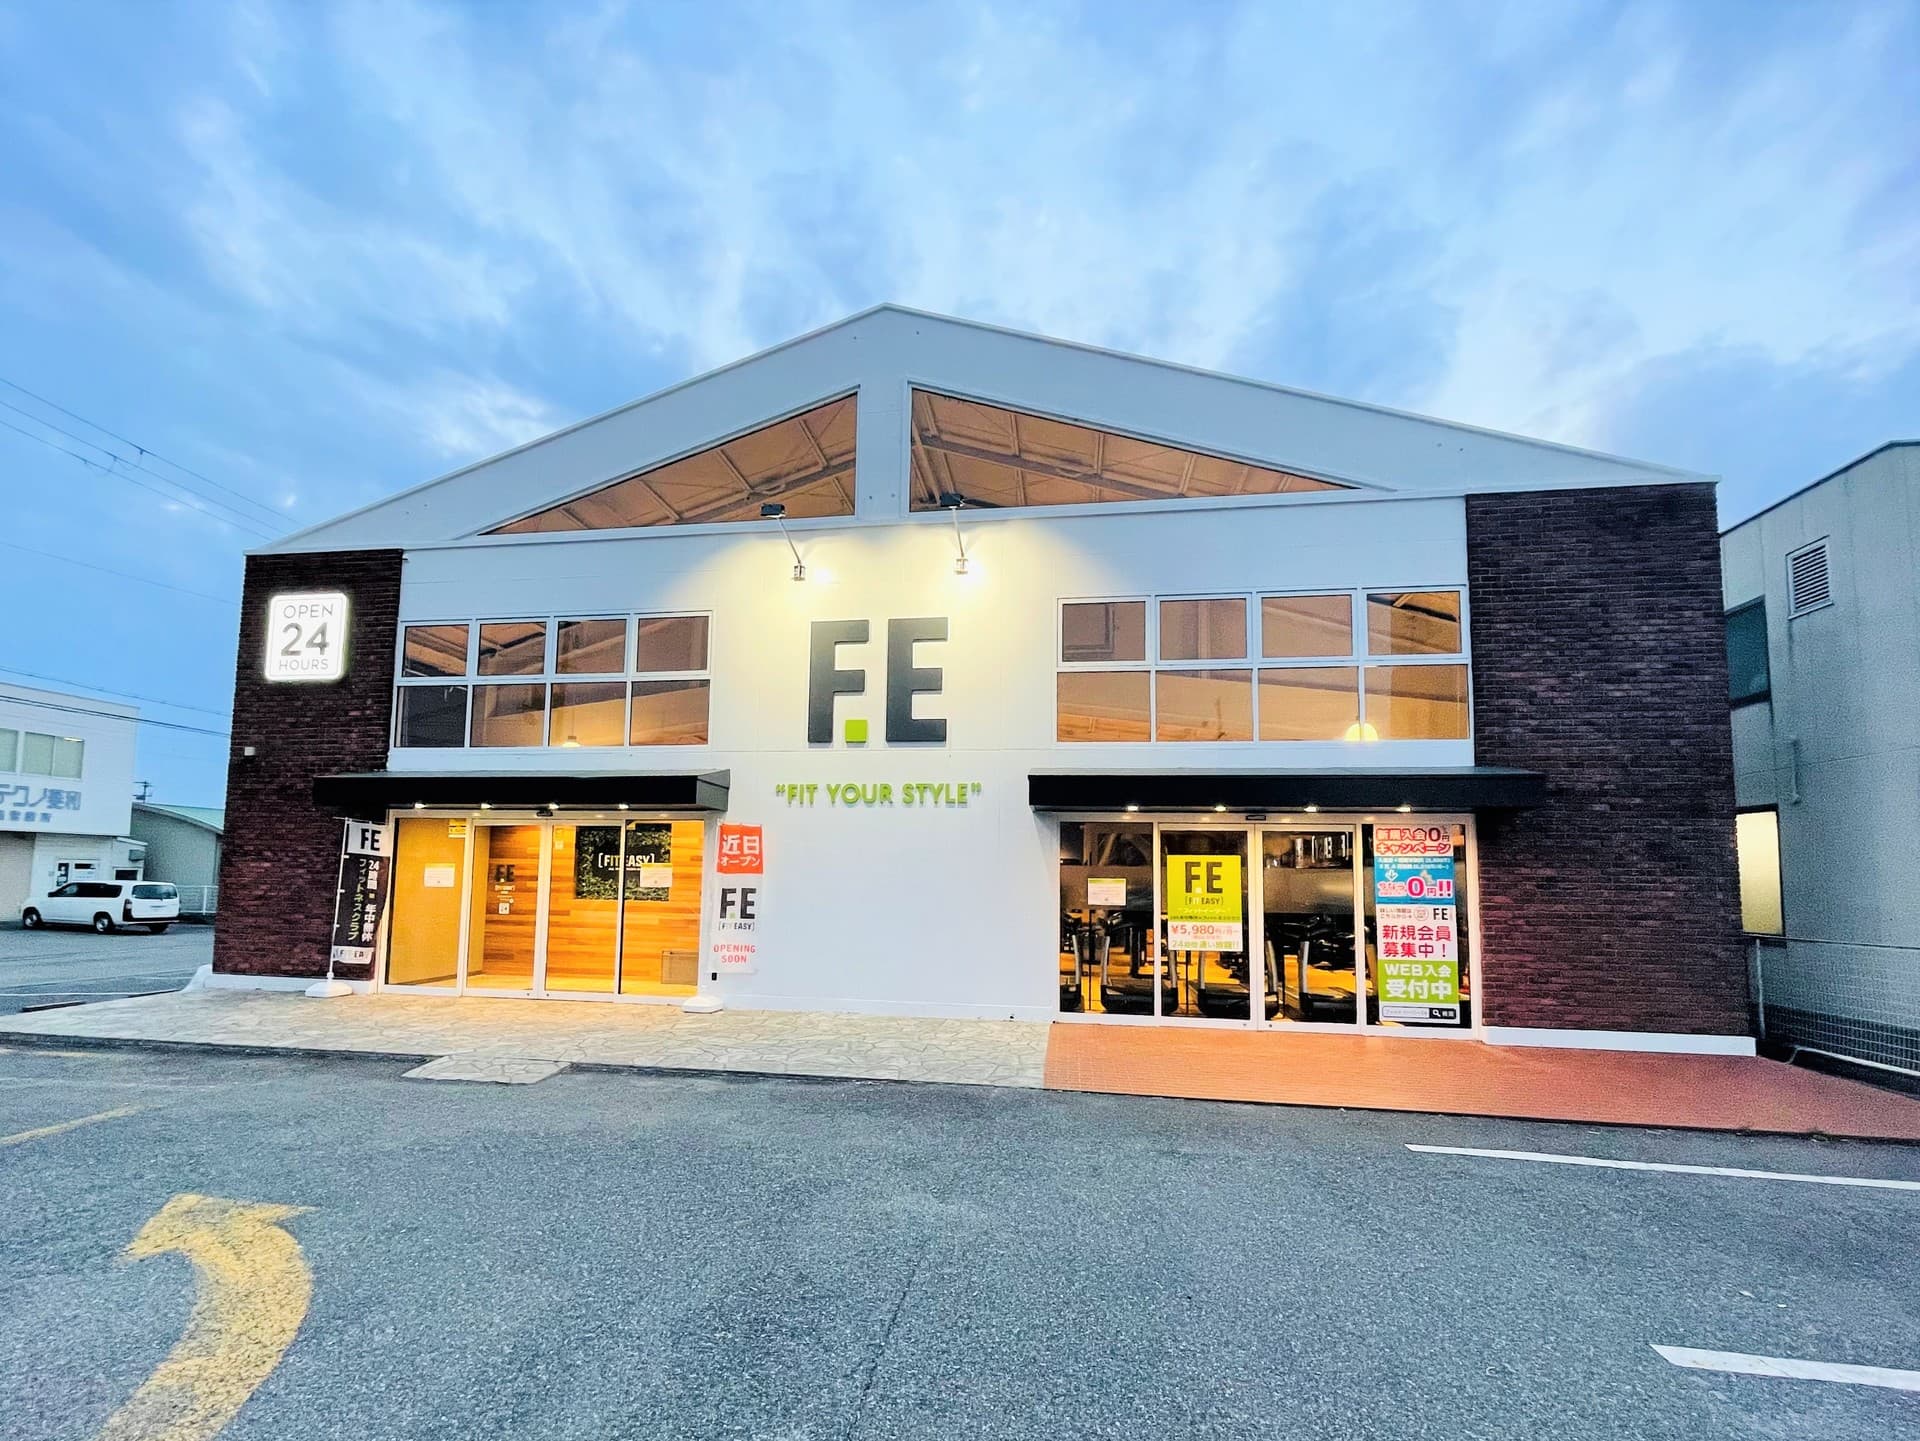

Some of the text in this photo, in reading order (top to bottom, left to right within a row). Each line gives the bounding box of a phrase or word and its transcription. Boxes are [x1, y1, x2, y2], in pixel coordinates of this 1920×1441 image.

[283, 603, 334, 619] OPEN
[280, 622, 330, 657] 24
[279, 658, 329, 672] HOURS
[826, 783, 894, 805] YOUR
[722, 834, 760, 855] 近日
[1376, 842, 1451, 854] キャンペーン
[720, 856, 760, 867] オープン
[1382, 925, 1452, 942] 新規会員
[713, 944, 756, 953] OPENING
[721, 954, 747, 963] SOON
[1384, 963, 1452, 978] WEB入会
[1386, 979, 1452, 1000] 受付中
